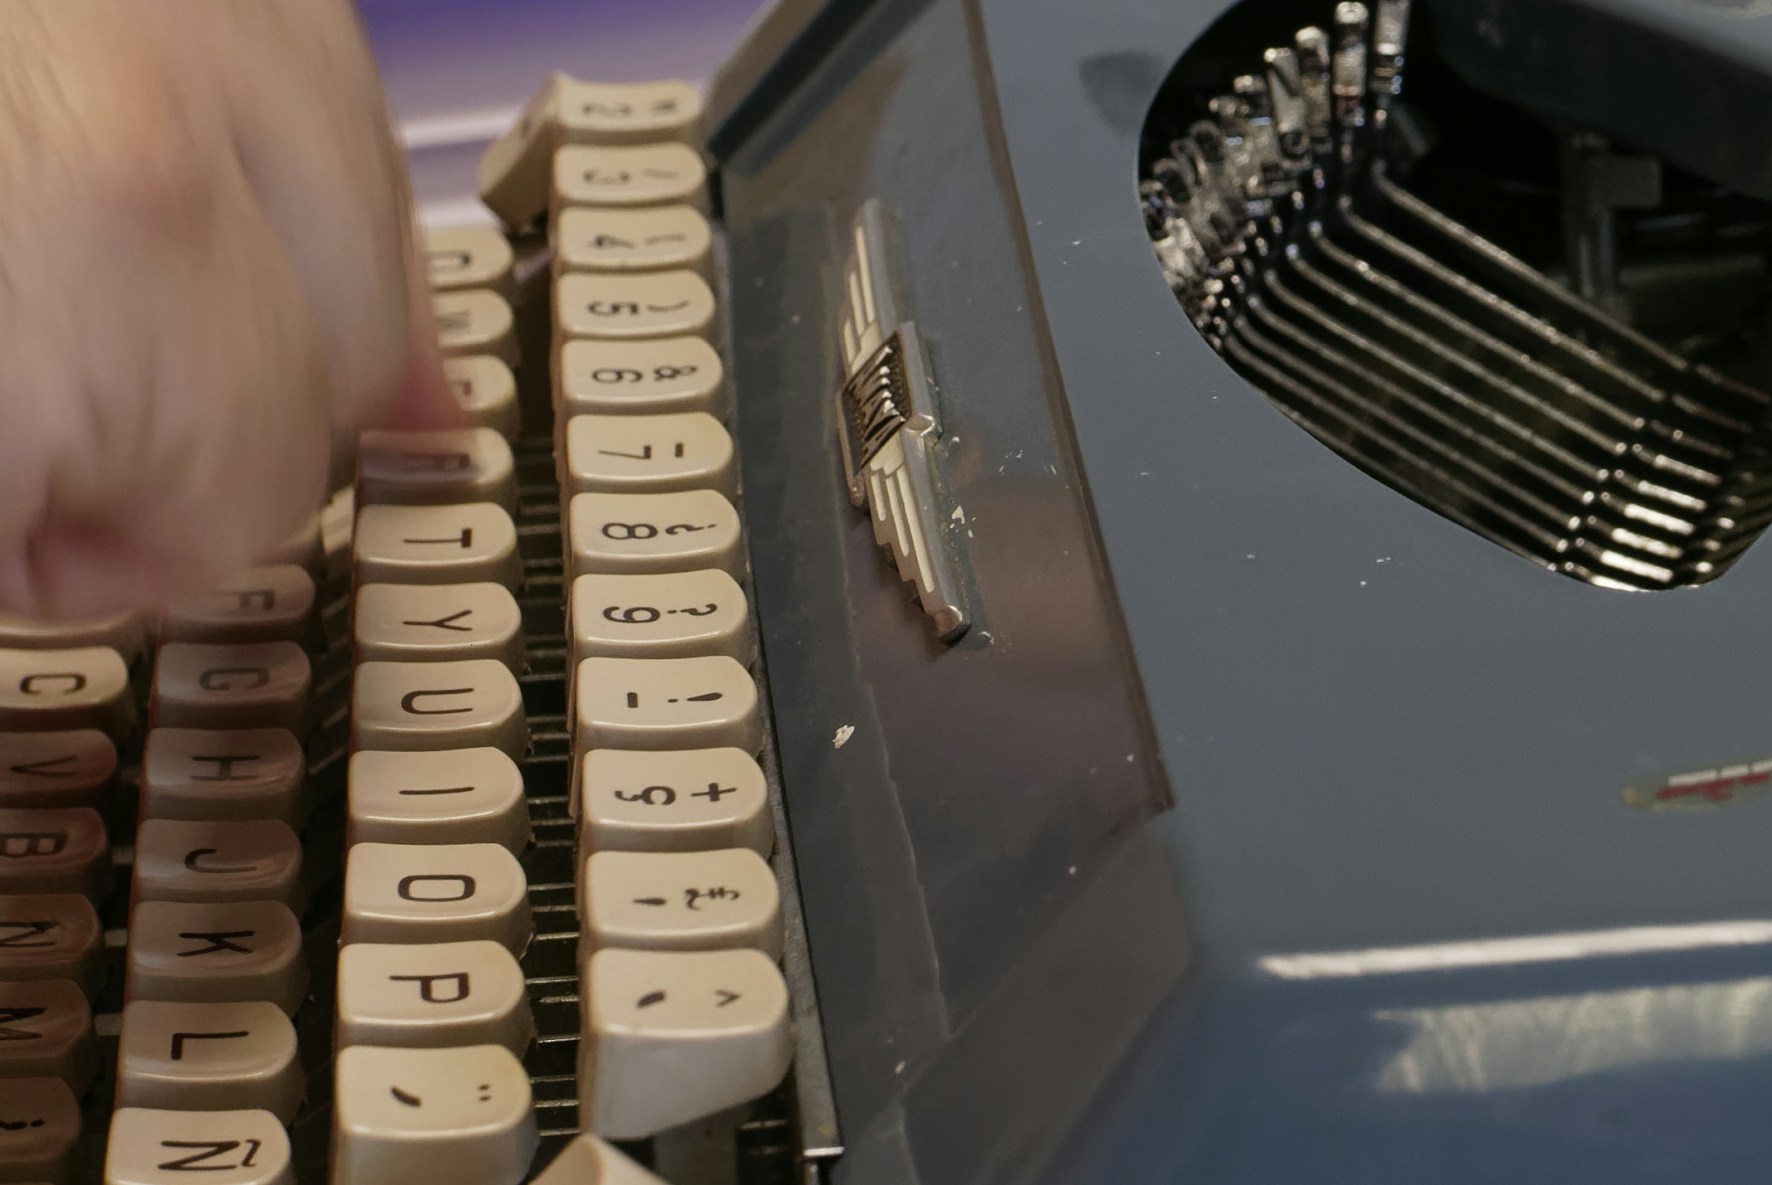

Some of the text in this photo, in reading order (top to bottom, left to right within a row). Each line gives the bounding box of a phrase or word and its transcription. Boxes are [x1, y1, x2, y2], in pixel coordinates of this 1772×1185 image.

[588, 301, 639, 317] 5
[592, 367, 642, 384] 6
[597, 445, 652, 461] 7
[403, 528, 472, 548] T
[601, 522, 659, 541] 8
[403, 609, 473, 632] Y
[602, 606, 661, 624] 9
[19, 672, 87, 696] C
[199, 665, 270, 692] G
[400, 687, 475, 715] U
[10, 755, 78, 777] V
[188, 754, 261, 781] H
[184, 847, 258, 873] J
[177, 930, 255, 958] K
[389, 972, 471, 1004] P
[170, 1030, 249, 1061] L
[156, 1137, 261, 1171] Ñ
